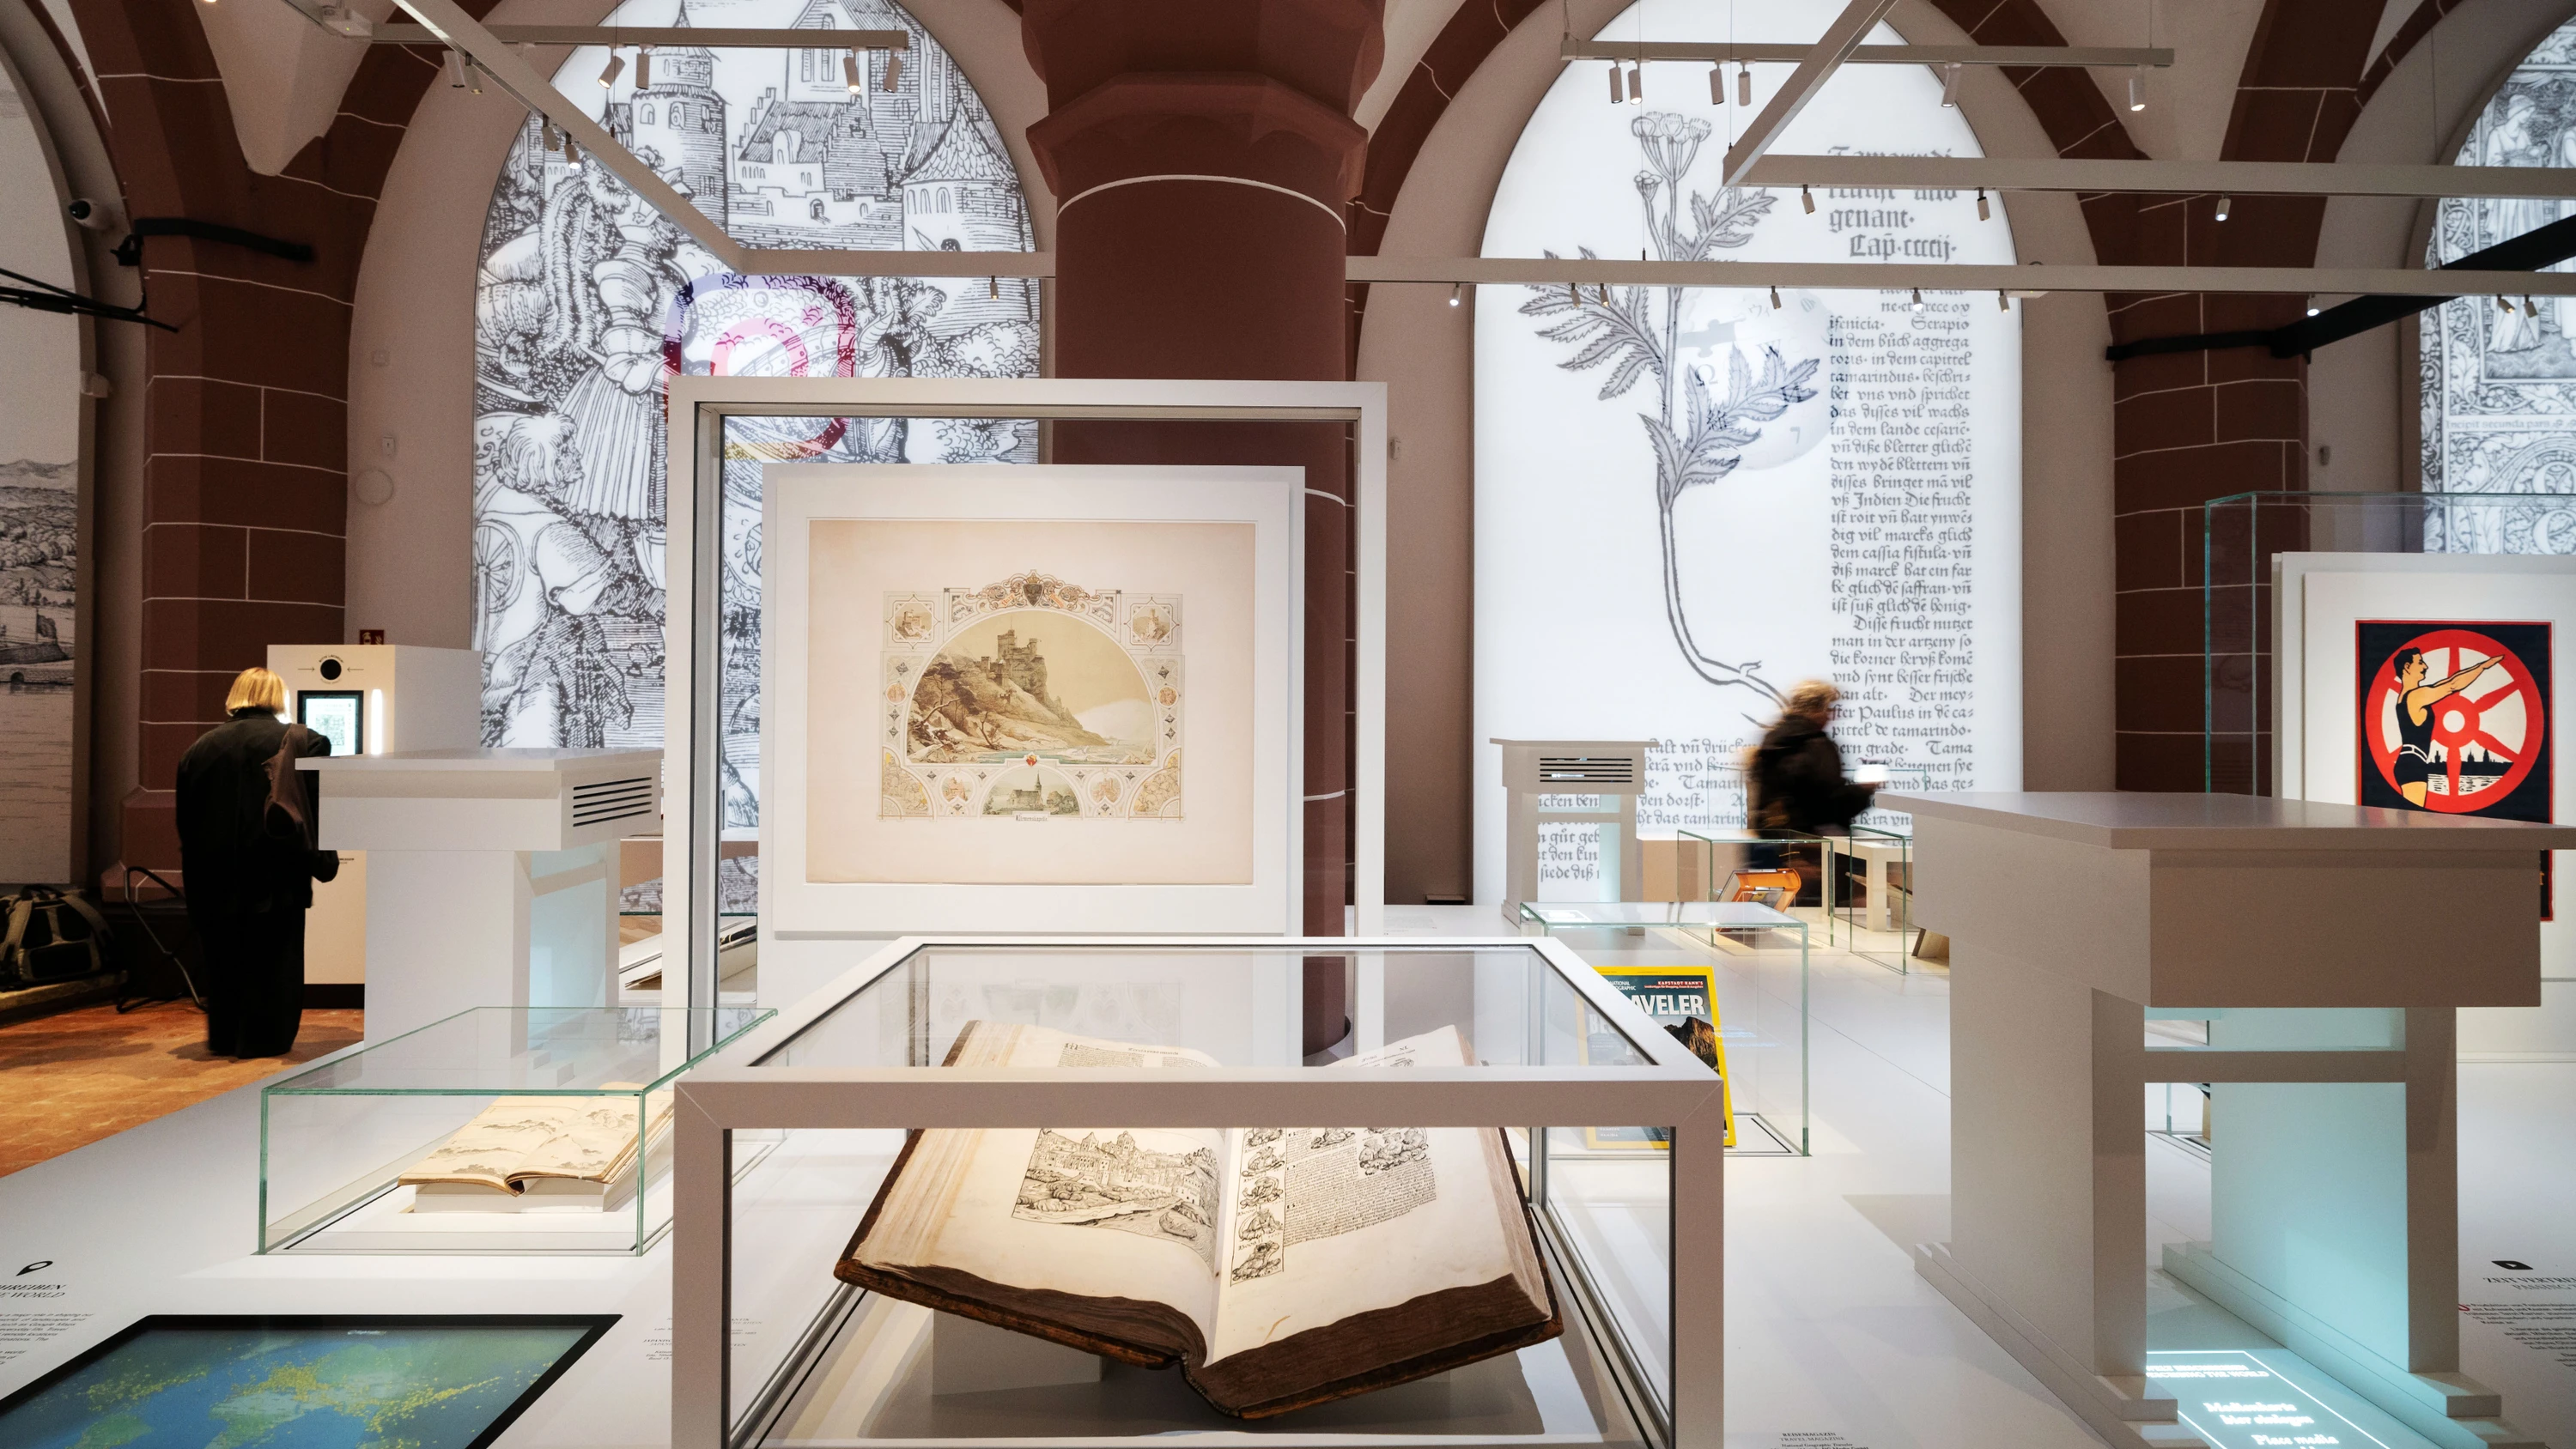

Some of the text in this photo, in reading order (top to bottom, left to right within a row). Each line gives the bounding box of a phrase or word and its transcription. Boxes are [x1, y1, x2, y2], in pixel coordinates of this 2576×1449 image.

[1829, 334, 1844, 347] in
[1846, 333, 1874, 348] dem
[1872, 355, 1885, 365] in
[1886, 351, 1917, 365] dem
[1888, 387, 1917, 400] vnd
[1830, 404, 1856, 418] das
[1831, 544, 1859, 559] dem
[1832, 637, 1864, 647] man
[1868, 634, 1882, 647] in
[1832, 670, 1860, 683] vnd
[1918, 705, 1932, 718] in
